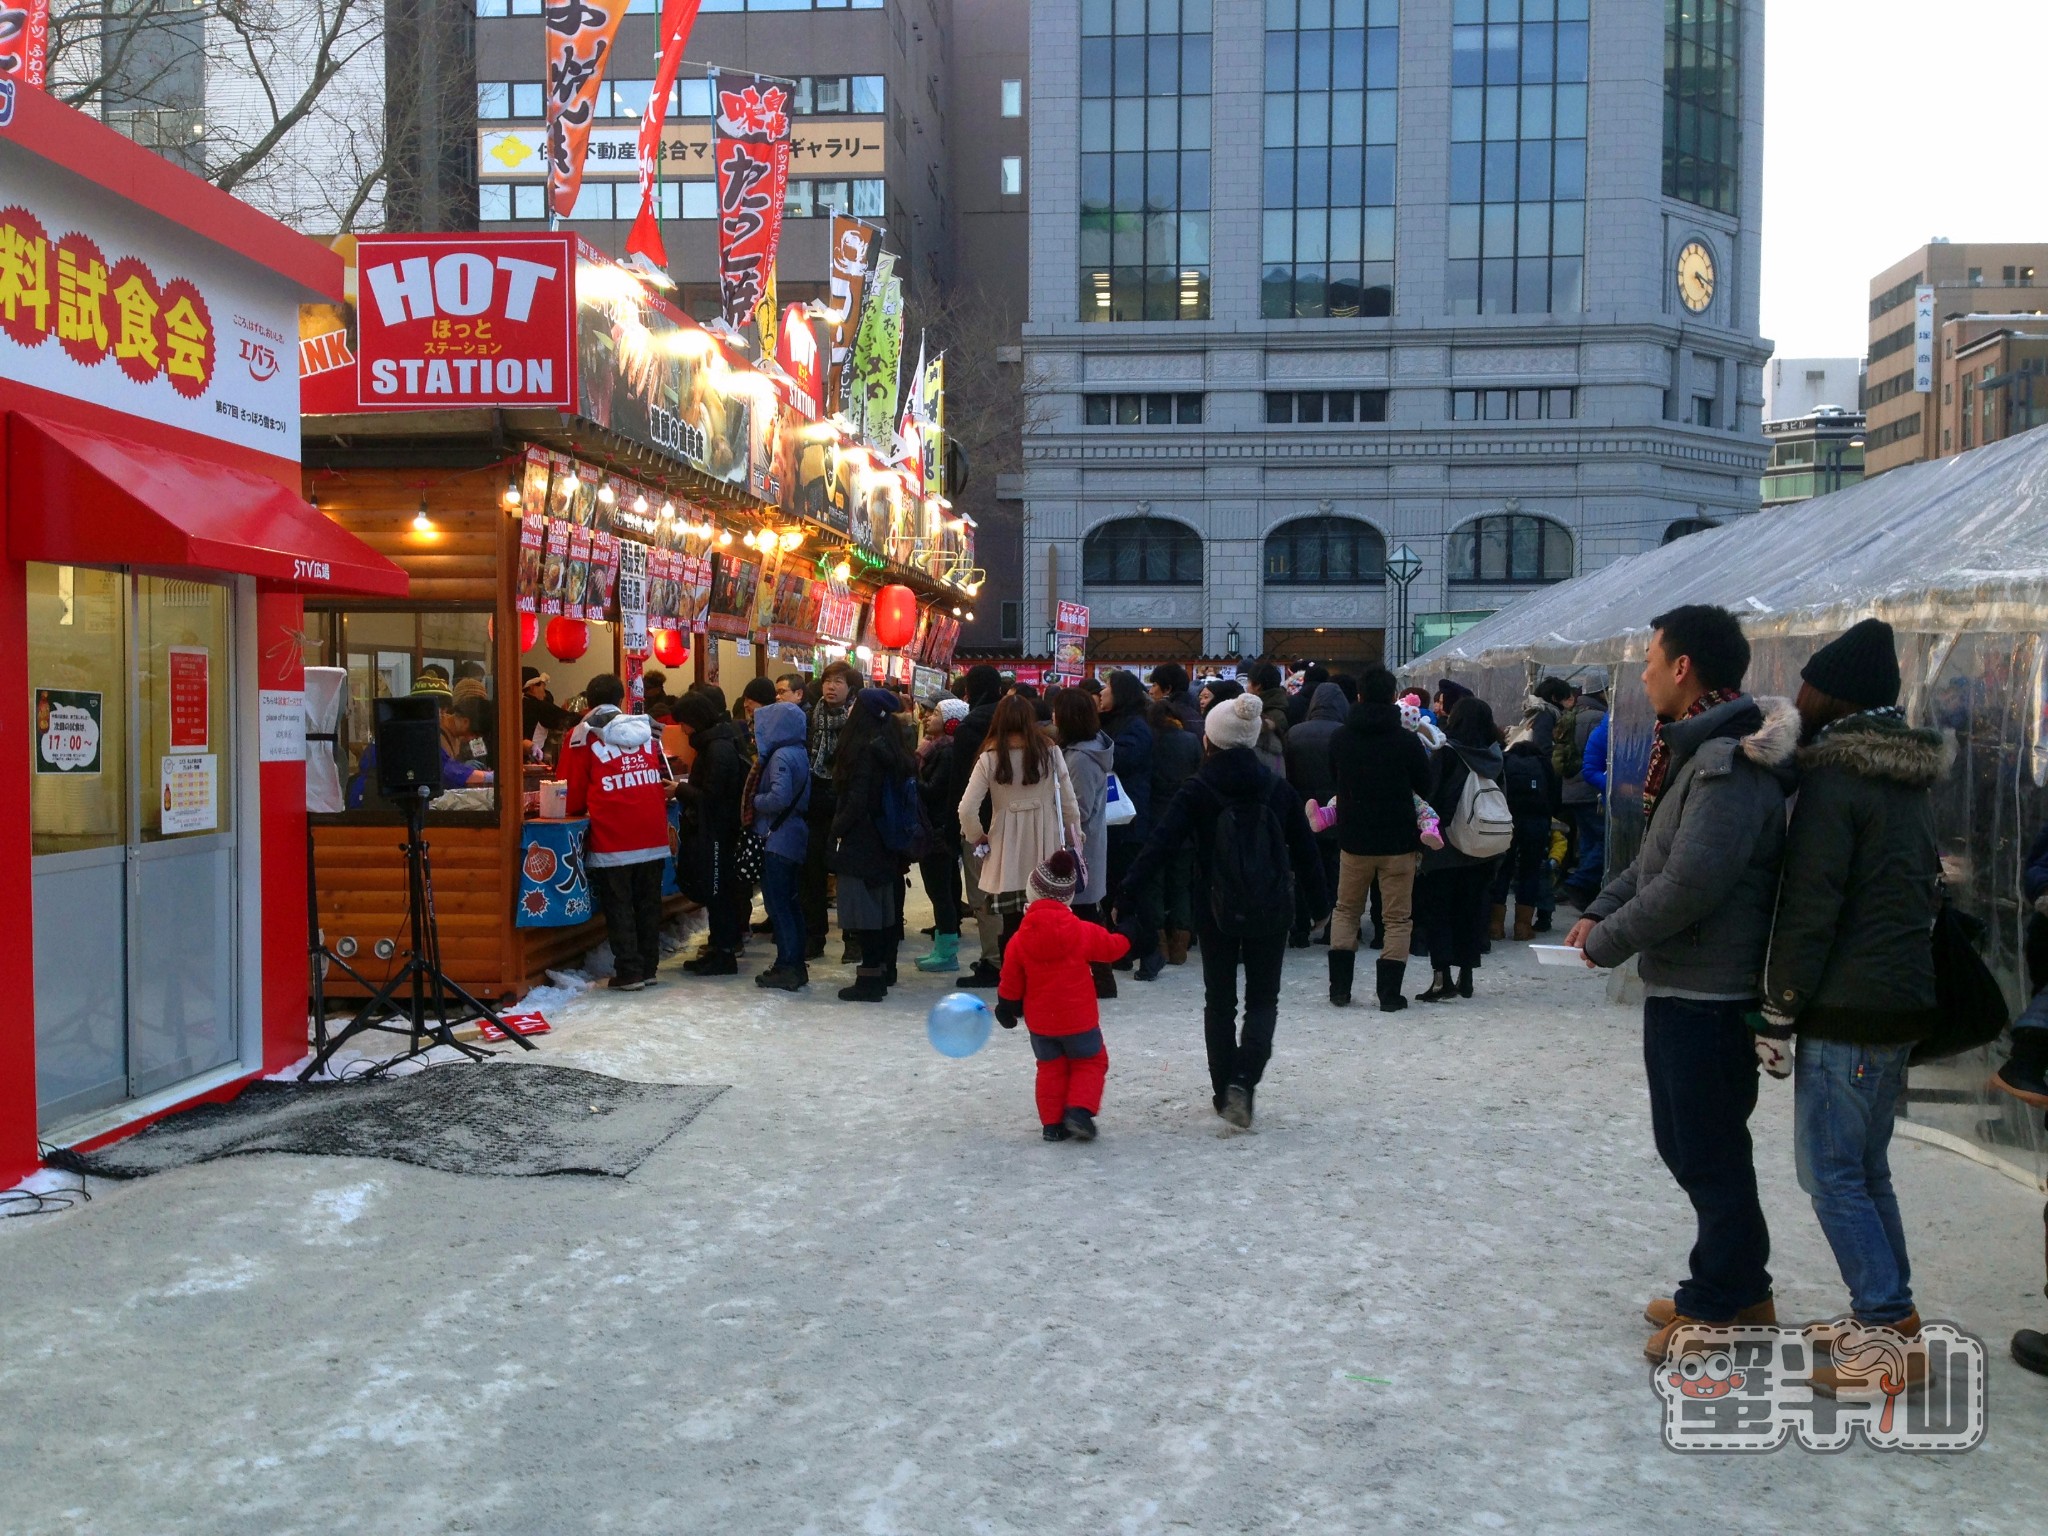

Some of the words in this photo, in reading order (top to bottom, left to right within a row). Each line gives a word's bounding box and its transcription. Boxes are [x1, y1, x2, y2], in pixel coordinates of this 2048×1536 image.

[366, 252, 557, 327] HOT
[431, 319, 492, 339] ほっと
[1917, 307, 1932, 386] 大塚商会
[238, 338, 280, 374] エバラ
[423, 341, 502, 355] ステーション
[372, 358, 553, 394] STATION
